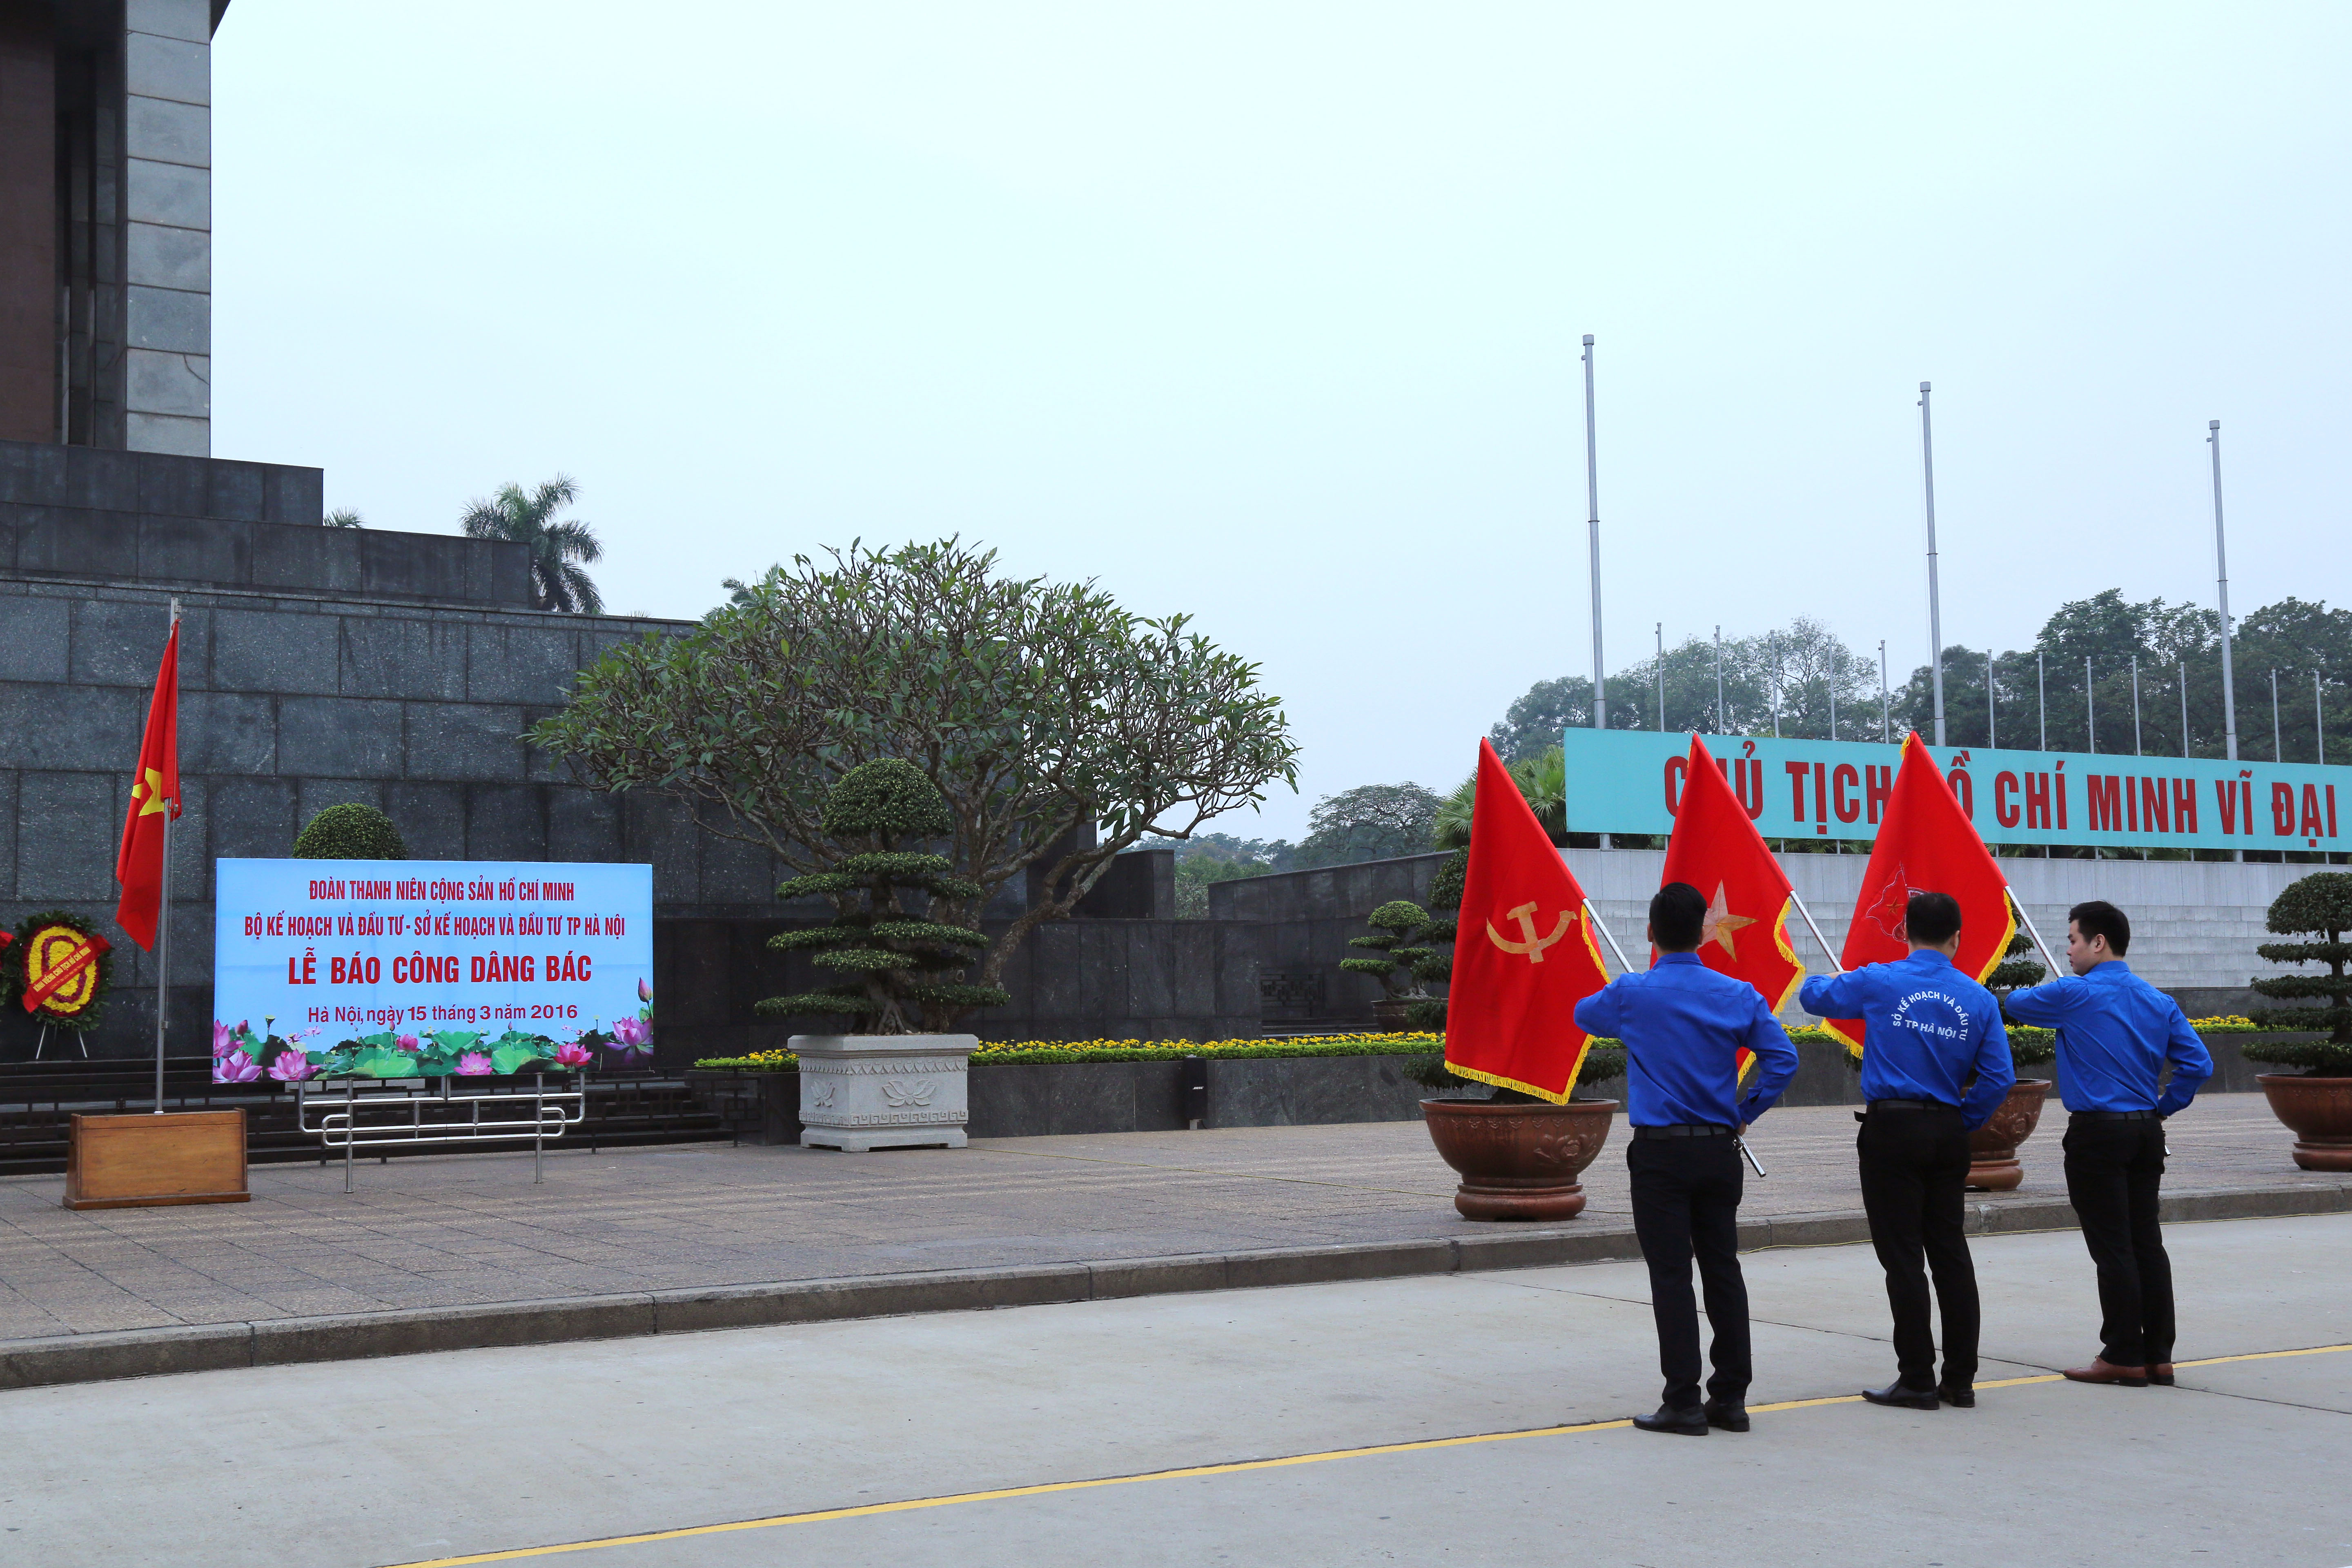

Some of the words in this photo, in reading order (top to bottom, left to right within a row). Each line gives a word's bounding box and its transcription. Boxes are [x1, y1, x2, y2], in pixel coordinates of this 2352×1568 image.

[1664, 740, 1764, 820] CỦ
[1785, 761, 1892, 835] TỊCH
[1994, 760, 2068, 830] CHÍ
[2087, 774, 2198, 833] MINH
[2216, 770, 2254, 835] VĨ
[2272, 782, 2337, 848] ĐẠI
[310, 877, 345, 900] ĐOÀN
[350, 880, 391, 899] THANH
[396, 878, 426, 900] NIÊN
[431, 878, 464, 904] CỘNG
[468, 875, 493, 900] SẢN
[499, 877, 515, 900] HỒ
[519, 879, 539, 900] CHÍ
[543, 882, 574, 901] MINH
[245, 912, 262, 940] BỘ
[267, 910, 285, 935] KẾ
[288, 917, 332, 940] HOẠCH
[338, 912, 354, 935] VÀ
[358, 911, 383, 935] ĐẦU
[388, 915, 405, 935] TƯ
[414, 909, 431, 935] SỞ
[434, 911, 451, 935] KẾ
[454, 917, 495, 939] HOẠCH
[499, 913, 514, 935] VÀ
[519, 912, 543, 935] ĐẦU
[547, 915, 563, 935] TƯ
[567, 917, 581, 935] TP
[585, 913, 600, 935] HÀ
[605, 914, 625, 940] NỘI
[288, 947, 316, 984] LỄ
[331, 951, 380, 984] BÁO
[393, 951, 459, 984] CÔNG
[471, 951, 535, 982] DÂNG
[546, 951, 591, 982] BÁC
[309, 1006, 329, 1022] Hà
[335, 1006, 363, 1025] Nội,
[367, 1005, 404, 1027] ngày
[408, 1006, 427, 1020] 15
[432, 1004, 475, 1023] tháng
[480, 1006, 491, 1020] 3
[495, 1003, 526, 1019] năm
[531, 1005, 578, 1018] 2016
[1891, 1013, 1902, 1027] SỞ
[1897, 997, 1910, 1013] KẾ
[1908, 991, 1940, 1004] HOẠCH
[1943, 994, 1956, 1007] VÀ
[1954, 1005, 1969, 1026] ĐẦU
[1904, 1019, 1919, 1029] TP
[1920, 1023, 1935, 1033] HÀ
[1937, 1027, 1957, 1039] NỘI
